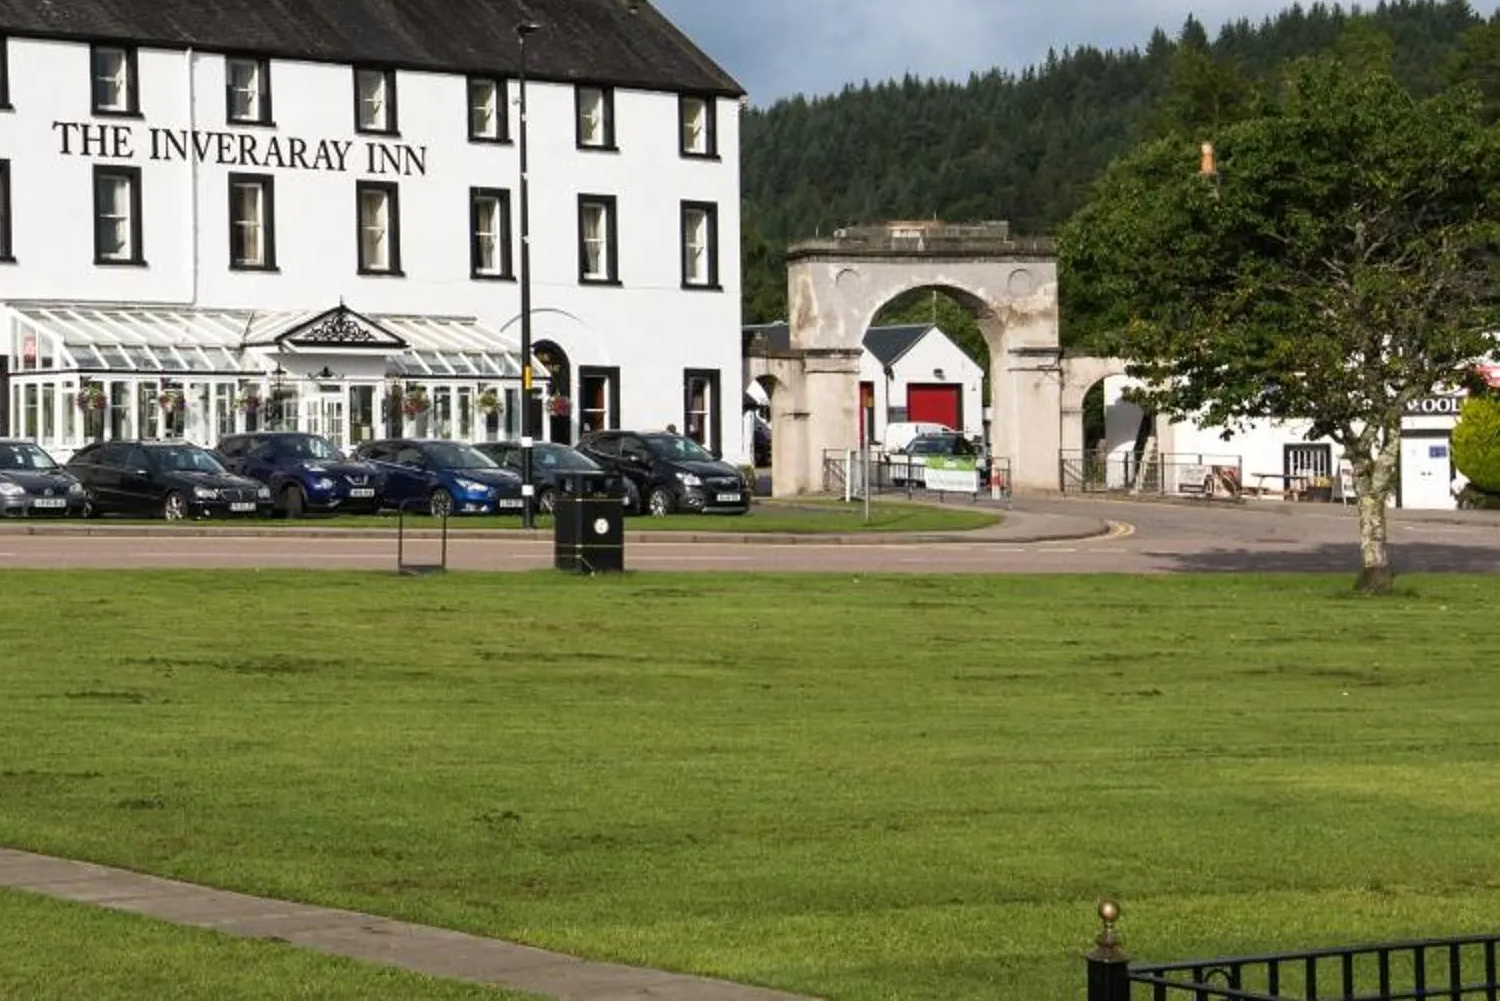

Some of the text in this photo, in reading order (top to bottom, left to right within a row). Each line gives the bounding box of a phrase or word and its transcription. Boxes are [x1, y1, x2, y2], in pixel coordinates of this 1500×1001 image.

[52, 120, 427, 176] THE INVERARAY INN
